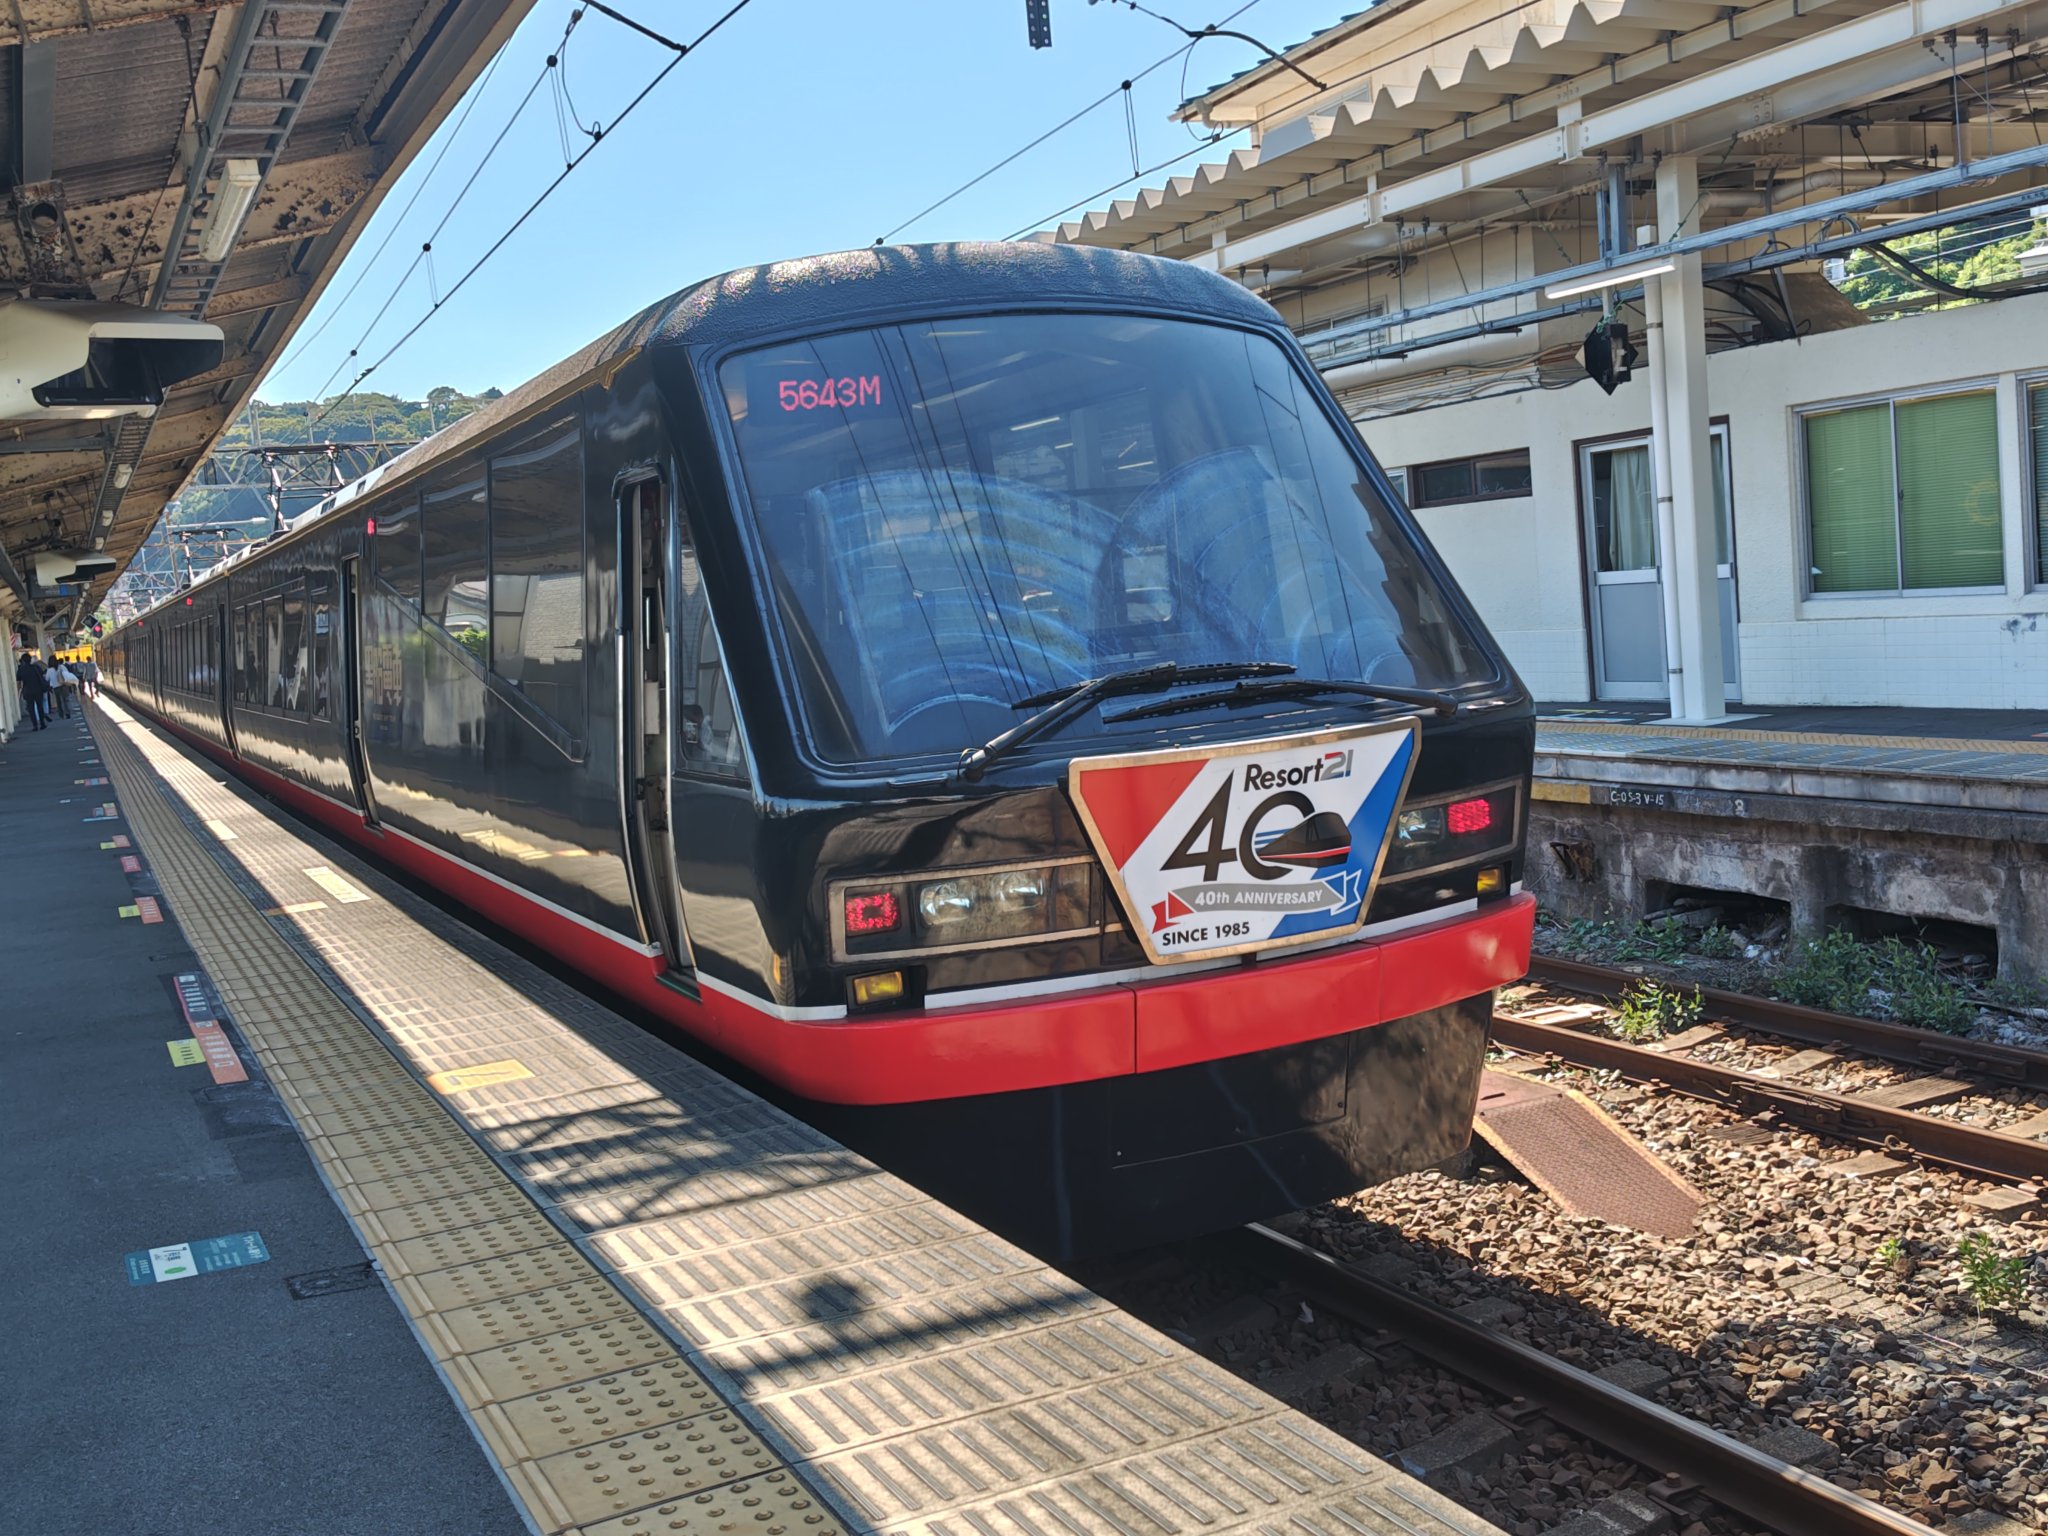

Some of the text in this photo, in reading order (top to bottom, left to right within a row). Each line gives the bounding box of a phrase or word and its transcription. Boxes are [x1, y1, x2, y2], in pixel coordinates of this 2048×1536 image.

[779, 375, 881, 411] 5643M
[1160, 769, 1342, 882] 40
[1194, 889, 1323, 906] 40th ANNIVERSARY
[1162, 921, 1250, 947] SINCE 1985
